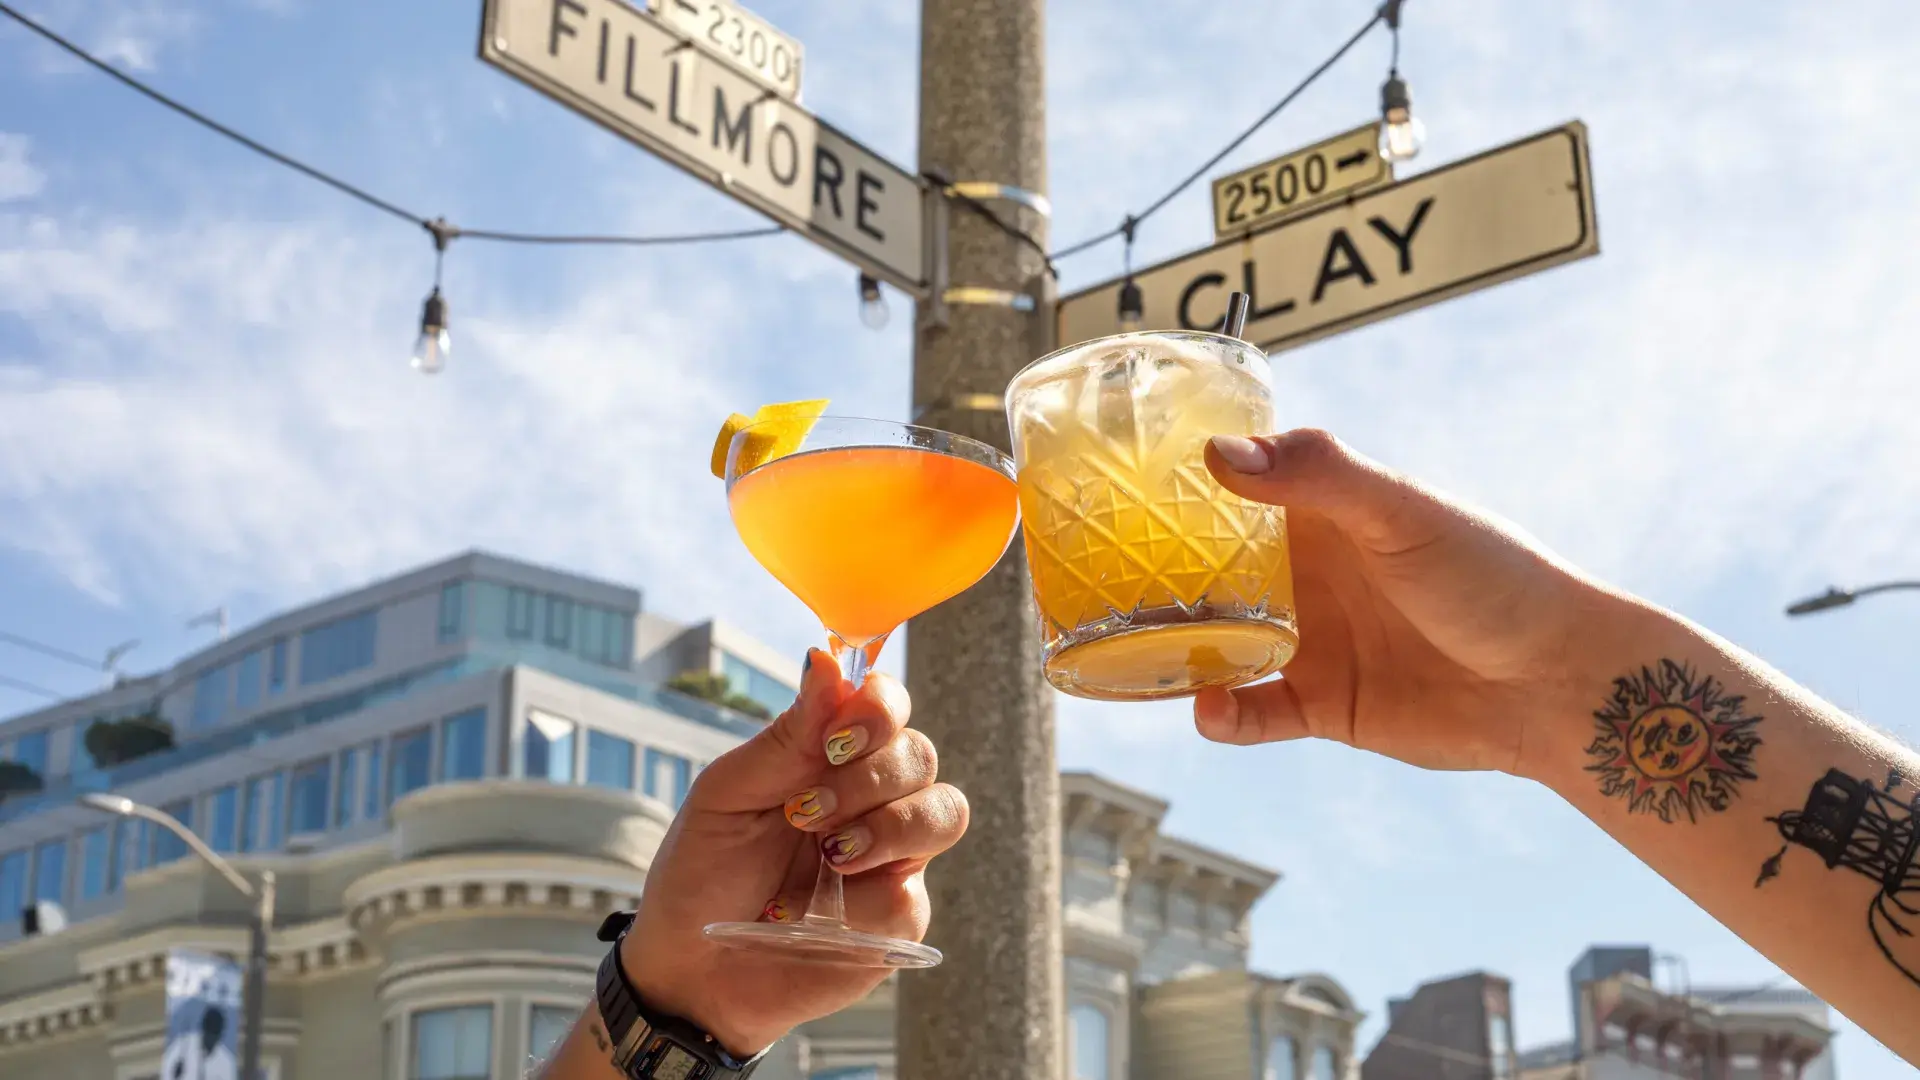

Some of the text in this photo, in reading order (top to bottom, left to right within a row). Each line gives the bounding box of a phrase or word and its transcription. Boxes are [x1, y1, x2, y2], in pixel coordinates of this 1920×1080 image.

[707, 4, 791, 82] 2300
[548, 0, 884, 242] FILLMORE
[1224, 153, 1327, 223] 2500
[1178, 196, 1435, 331] CLAY
